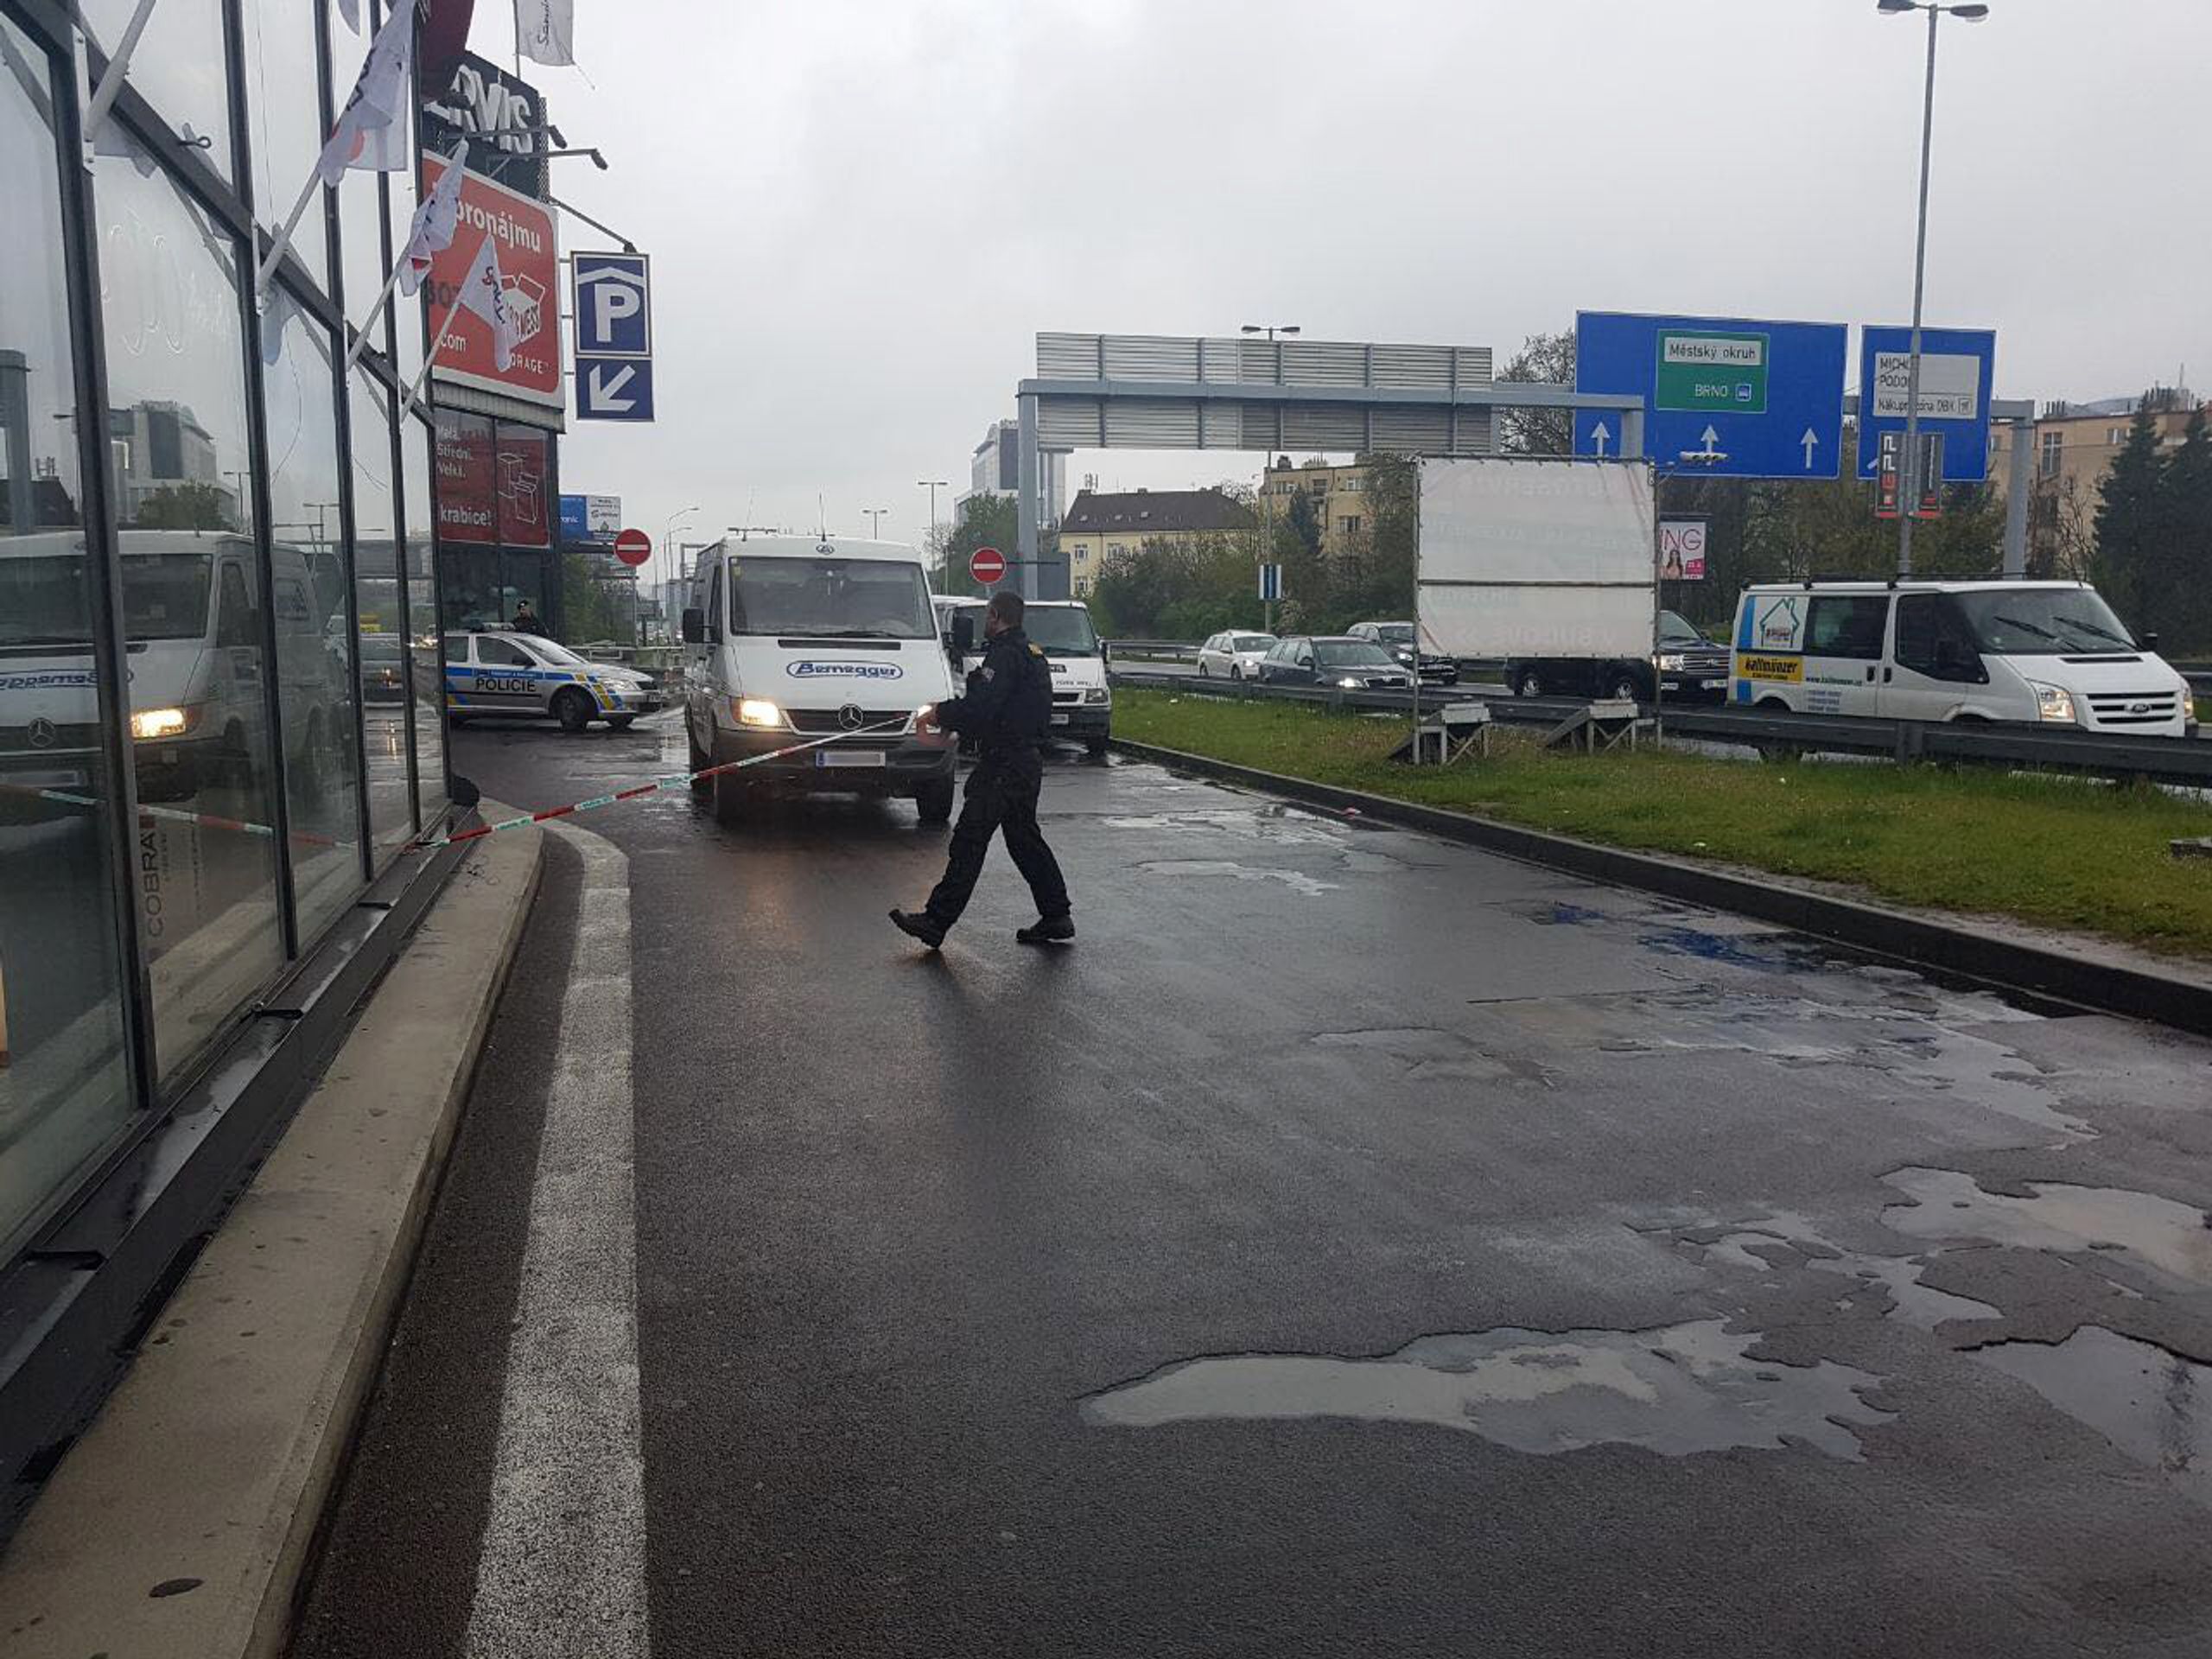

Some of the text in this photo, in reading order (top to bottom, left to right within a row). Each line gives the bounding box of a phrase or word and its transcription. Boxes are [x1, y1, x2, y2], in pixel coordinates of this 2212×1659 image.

[423, 64, 533, 154] RVIS
[594, 283, 640, 342] P
[1722, 346, 1756, 359] okruh
[1694, 383, 1728, 397] BRNO
[475, 677, 537, 692] POLICIE
